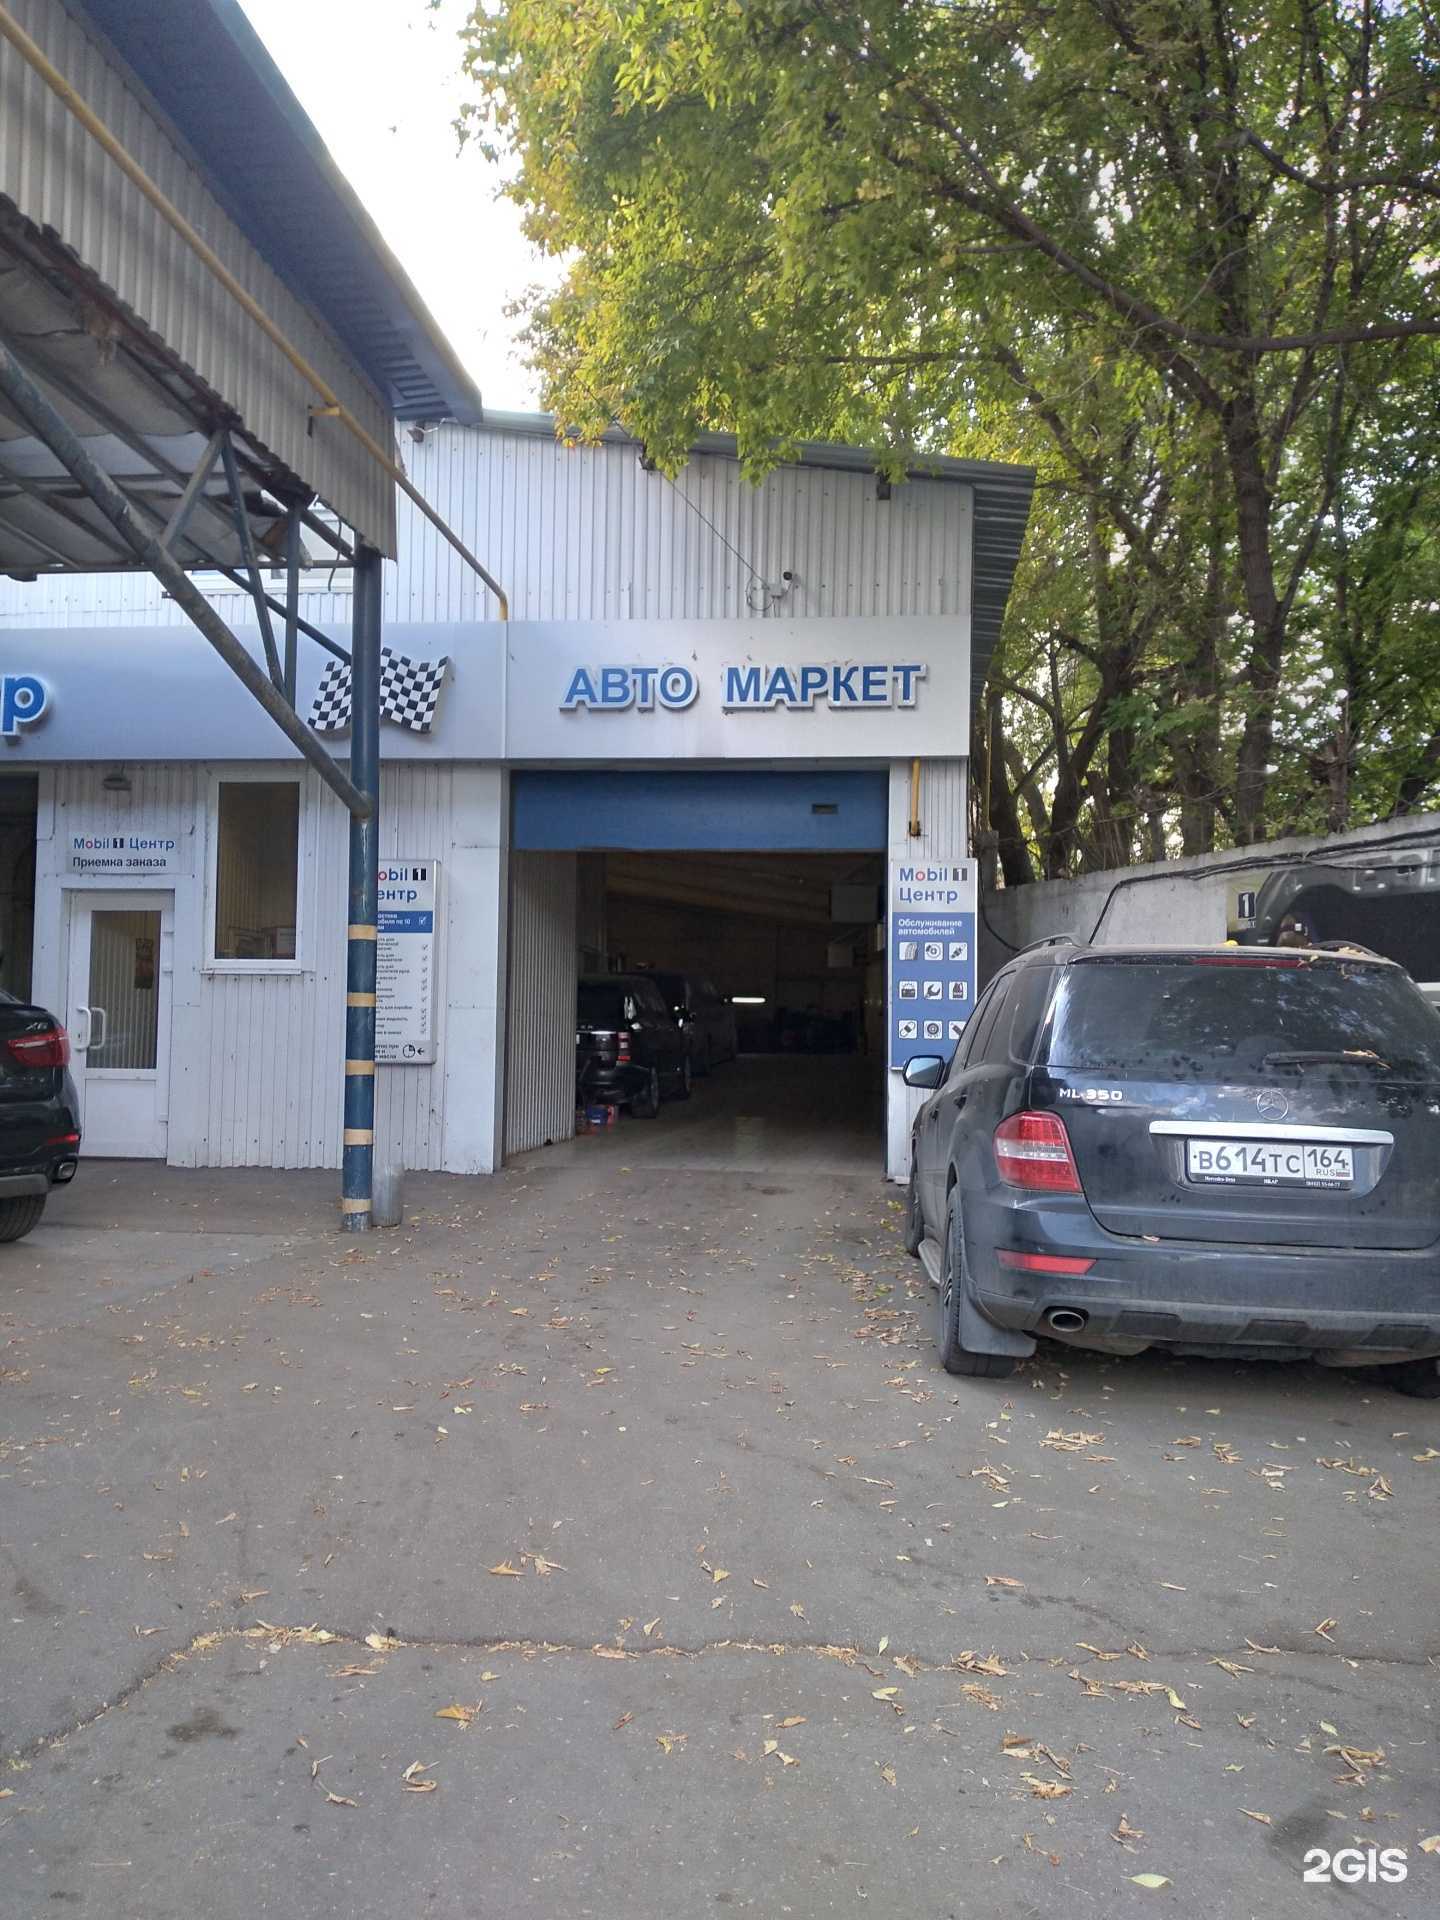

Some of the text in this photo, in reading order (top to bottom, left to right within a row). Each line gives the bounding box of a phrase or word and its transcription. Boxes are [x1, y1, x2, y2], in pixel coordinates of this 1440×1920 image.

[562, 665, 925, 708] АВТО МАРКЕТ
[73, 837, 110, 849] Mobil
[129, 838, 175, 851] Центр
[72, 857, 167, 869] Приемка заказа
[377, 867, 408, 881] obil
[899, 867, 966, 882] Mobil 1
[377, 889, 417, 904] ентр
[899, 888, 959, 904] Центр
[898, 918, 963, 929] Обслуживание
[898, 926, 956, 936] автомобилей
[1059, 1087, 1123, 1101] ML 350
[1307, 1148, 1347, 1169] 164
[1315, 1168, 1336, 1177] RUS
